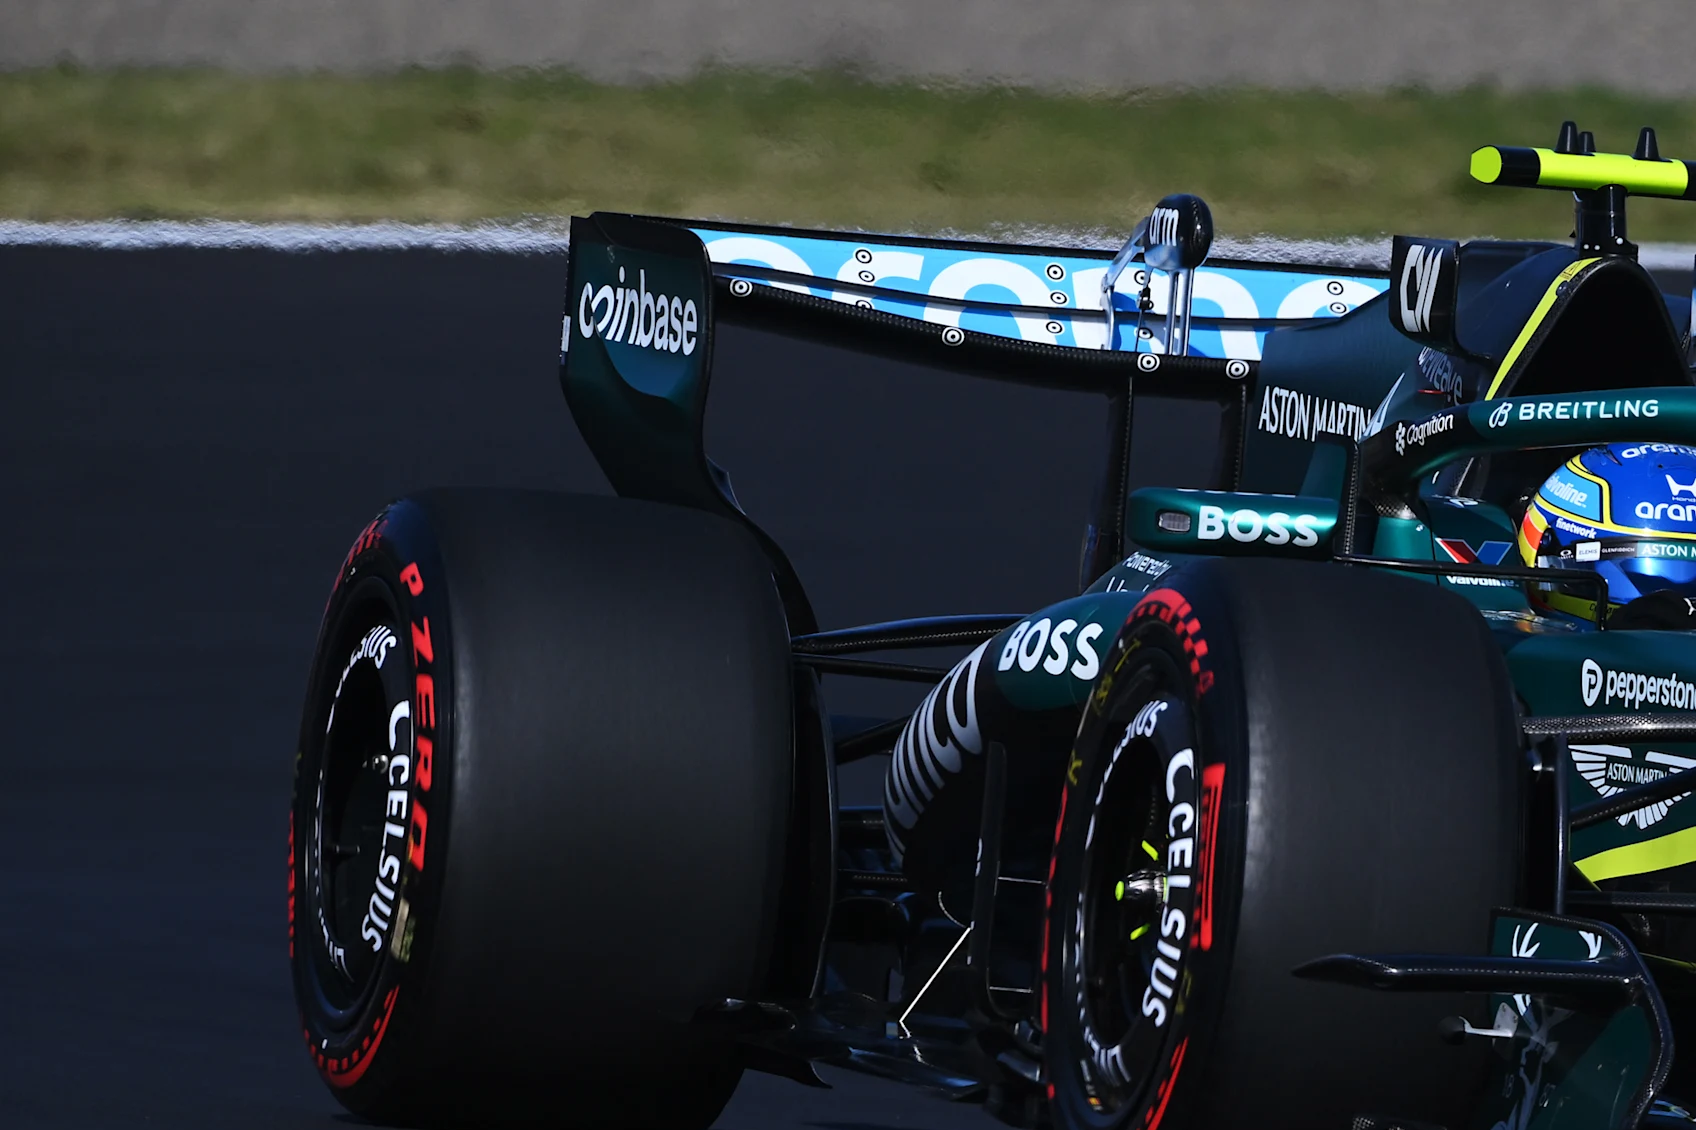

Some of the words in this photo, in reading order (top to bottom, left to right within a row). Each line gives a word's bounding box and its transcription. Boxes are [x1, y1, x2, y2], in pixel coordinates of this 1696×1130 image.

[1148, 205, 1181, 247] arm
[578, 266, 699, 356] coinbase
[1257, 385, 1312, 441] ASTON
[1312, 396, 1373, 443] MARTIN
[1405, 413, 1455, 447] Cognition
[1517, 399, 1660, 421] BREITLING
[1198, 505, 1320, 548] BOSS
[1555, 517, 1598, 540] finetwork
[1641, 542, 1689, 558] ASTON
[997, 617, 1104, 681] BOSS
[1606, 762, 1635, 784] ASTON
[1635, 766, 1669, 786] MARTIN
[360, 753, 412, 953] CELSIUS
[1140, 801, 1195, 1029] CELSIUS
